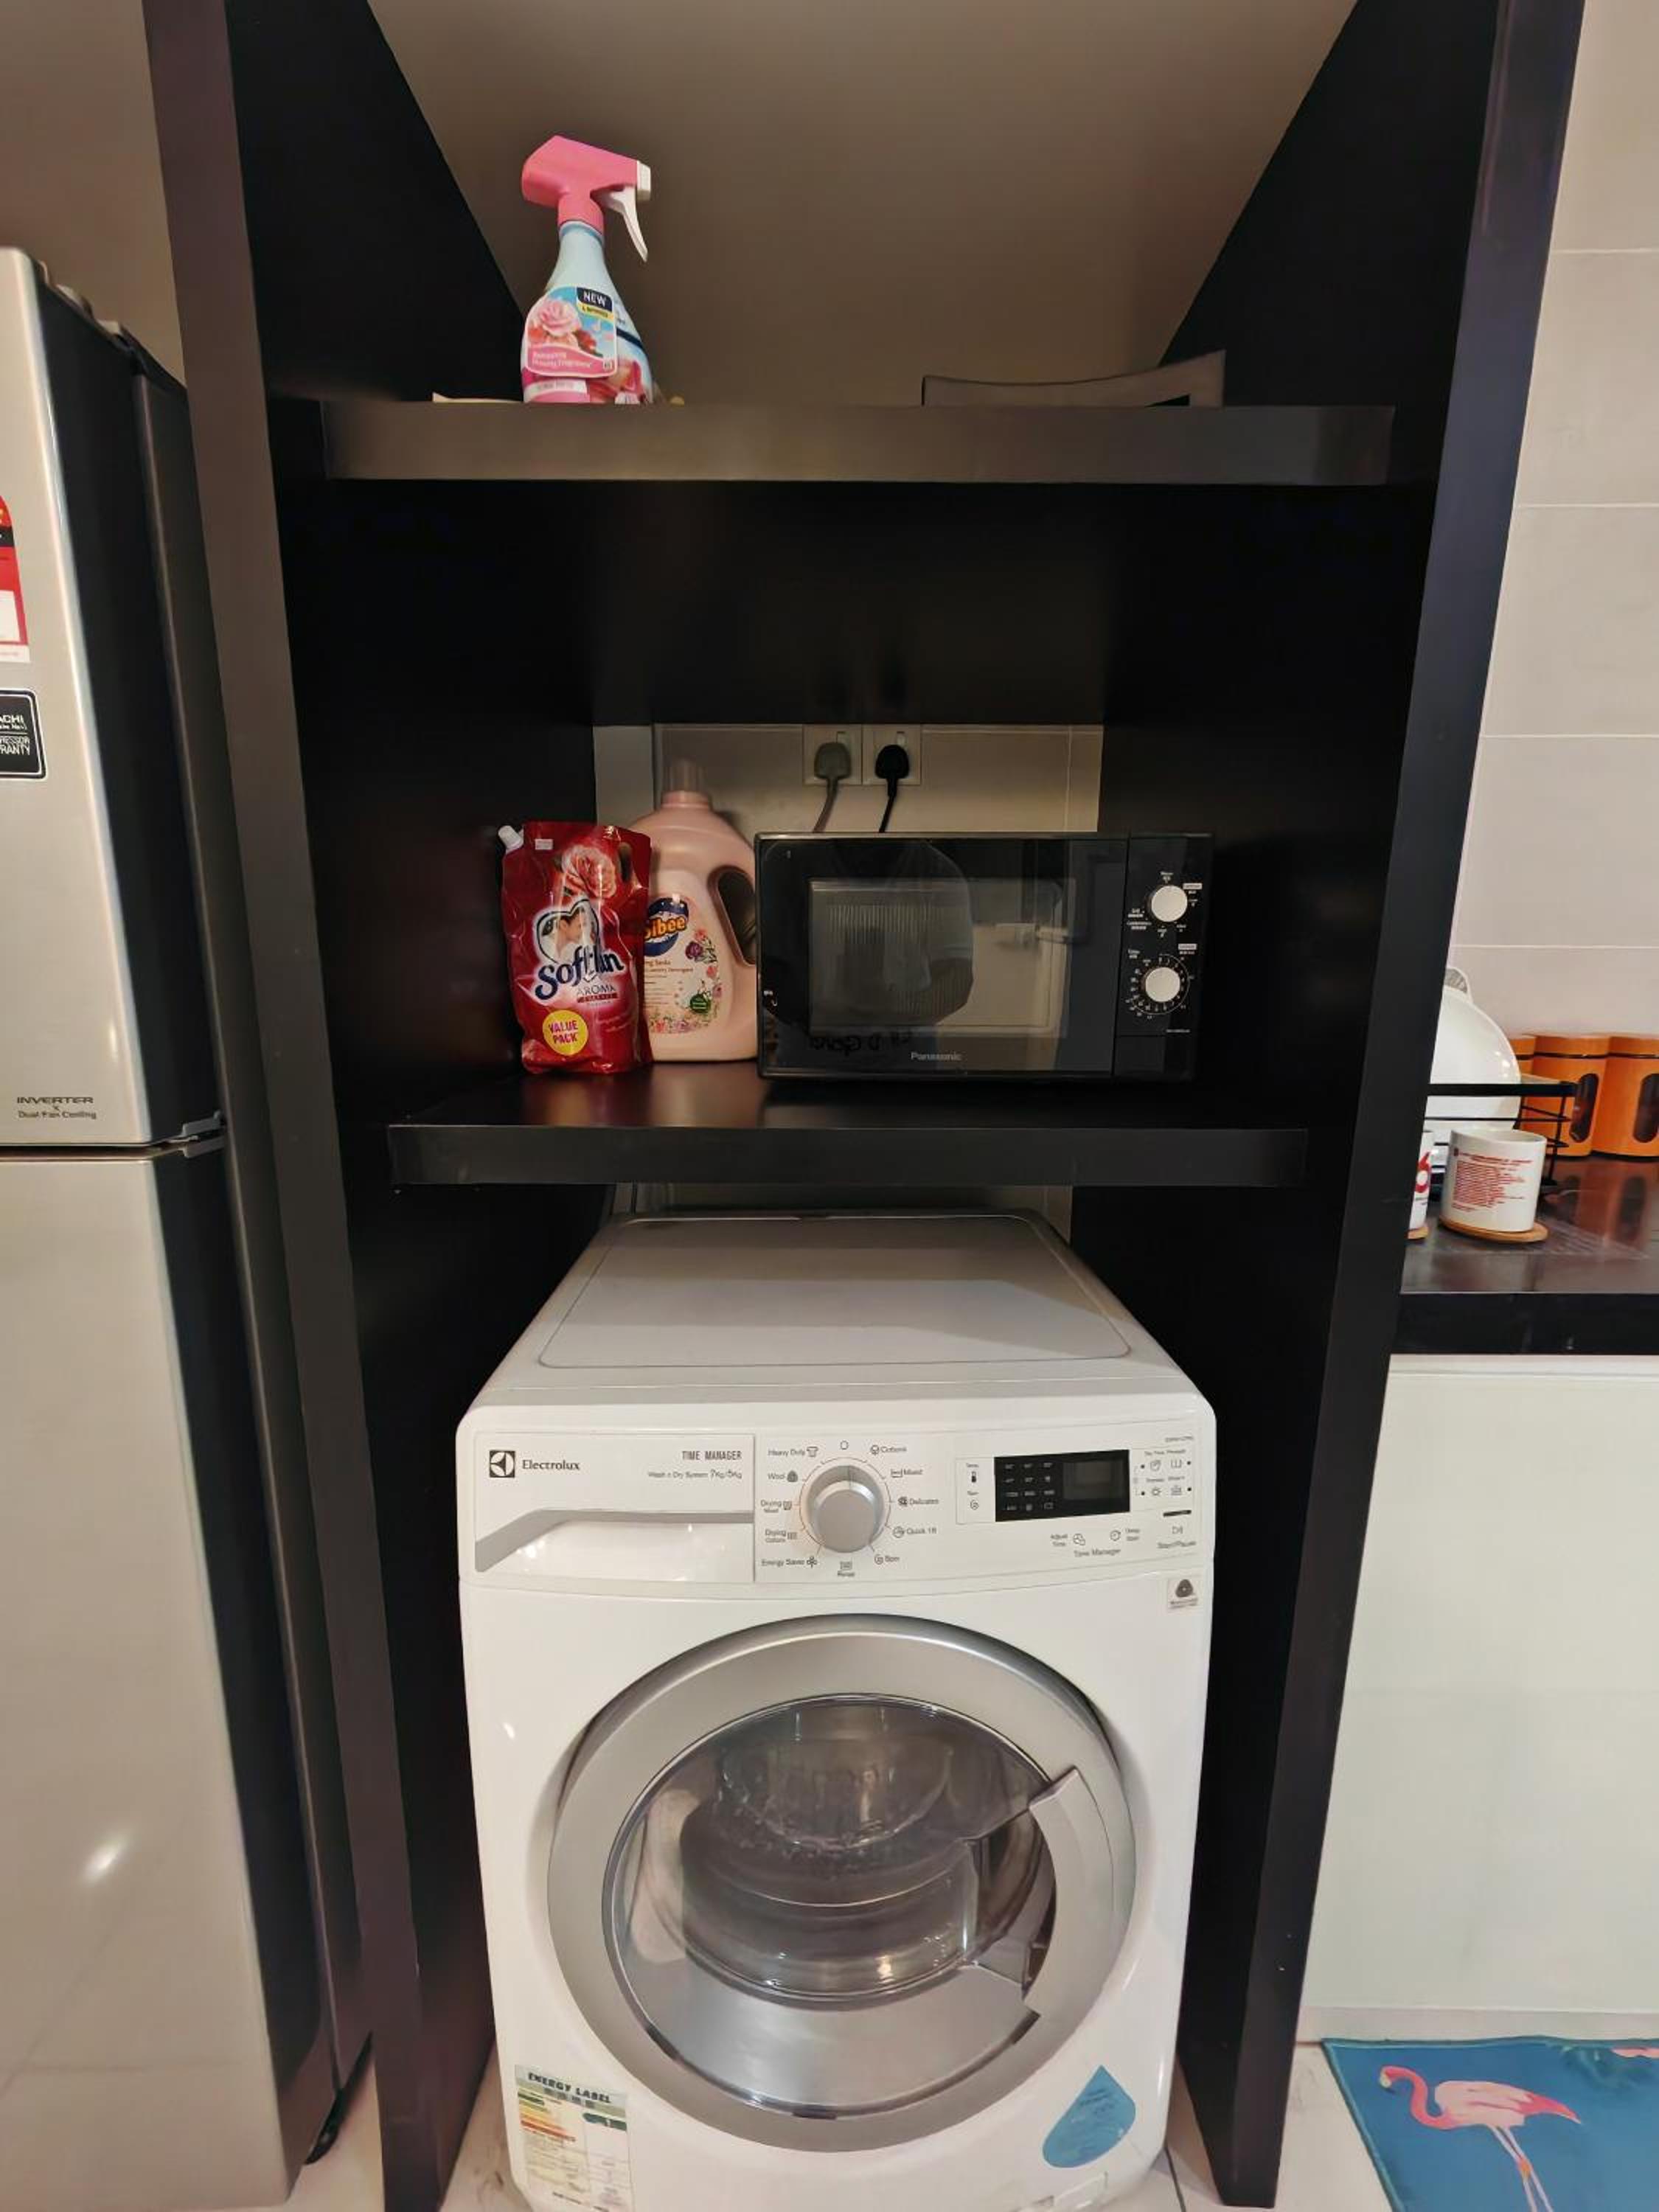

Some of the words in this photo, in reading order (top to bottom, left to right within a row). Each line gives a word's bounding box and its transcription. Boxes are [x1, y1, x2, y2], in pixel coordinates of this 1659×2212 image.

[583, 290, 606, 307] NEW
[548, 1020, 579, 1032] VALUE
[553, 1034, 578, 1044] PACK
[911, 1051, 961, 1060] Panasonic
[682, 1450, 700, 1461] TIME
[704, 1450, 742, 1461] MANAGER
[522, 1458, 580, 1471] Electrolux
[760, 1500, 782, 1508] Drying
[528, 2072, 571, 2092] ENERGY
[575, 2087, 611, 2104] LABEL
